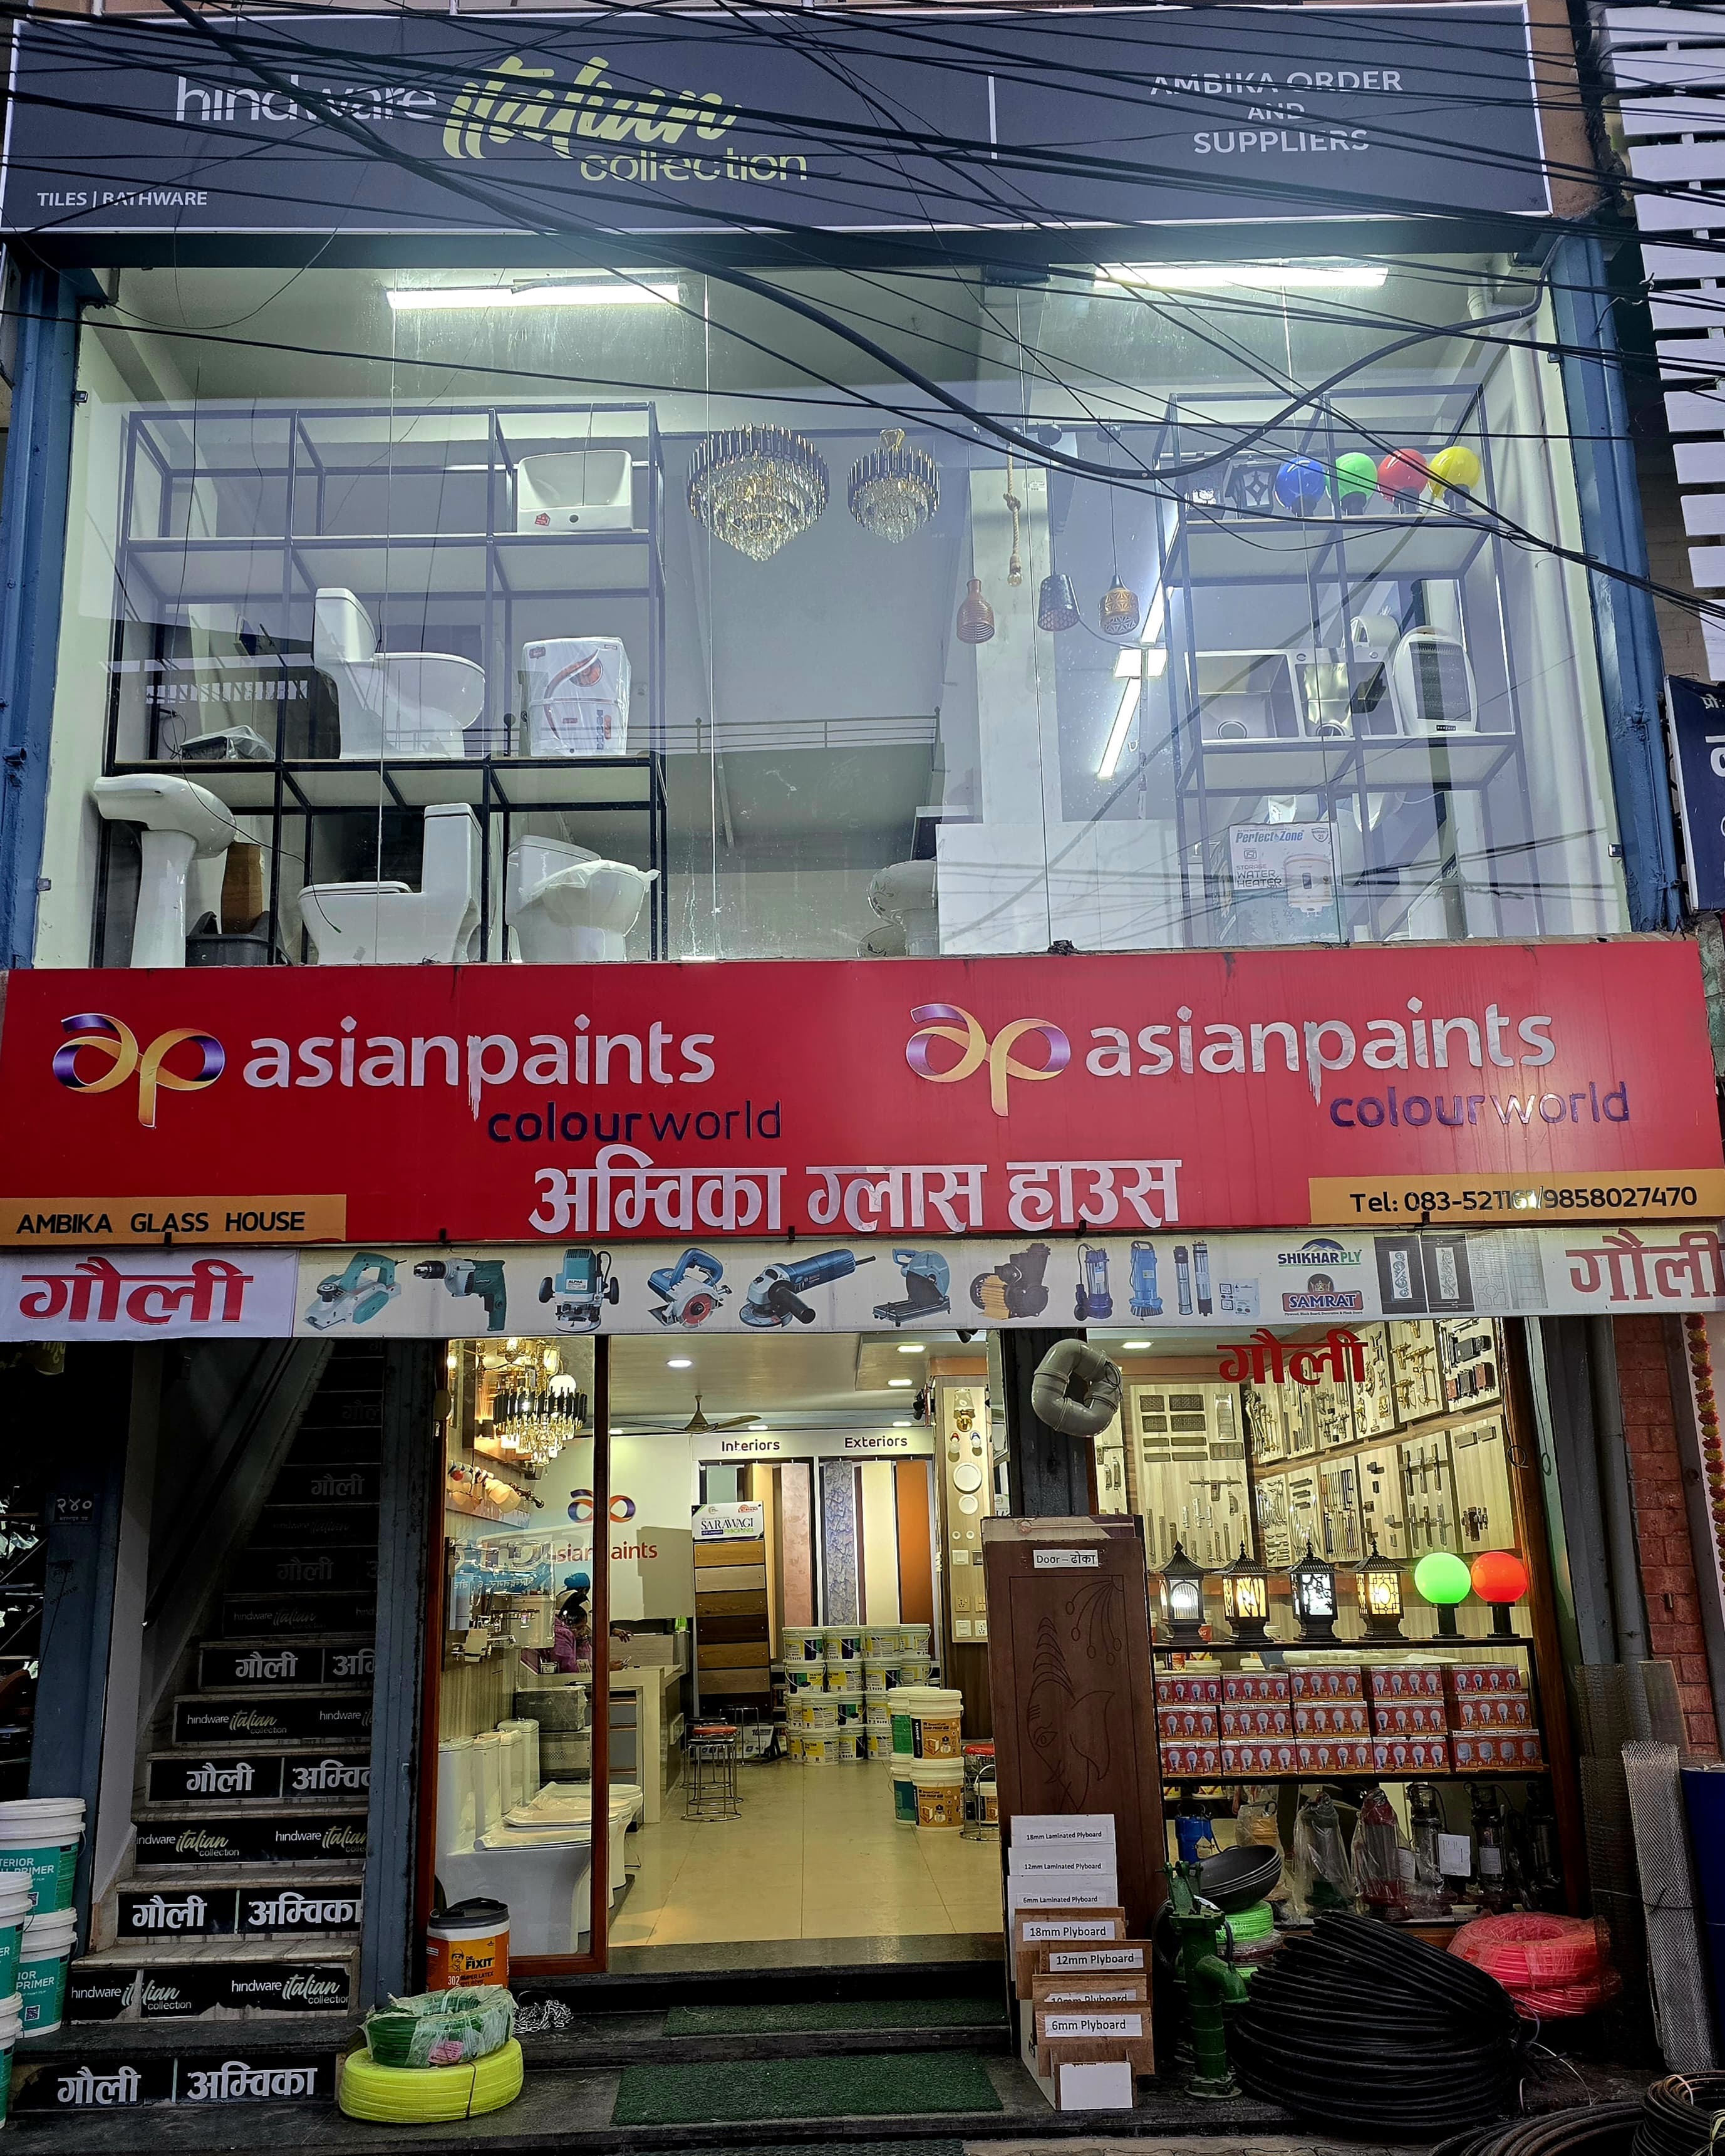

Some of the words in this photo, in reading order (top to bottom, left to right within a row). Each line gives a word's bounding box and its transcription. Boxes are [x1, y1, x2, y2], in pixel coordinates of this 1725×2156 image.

[1151, 73, 1278, 95] AMBIKA
[1287, 70, 1403, 93] ORDER
[1247, 102, 1305, 120] AND
[1194, 130, 1370, 153] SUPPLIERS
[580, 147, 807, 182] collection
[38, 192, 87, 207] TILES
[103, 190, 208, 207] BATHWARE
[1236, 831, 1277, 844] Perfect
[1278, 831, 1303, 842] Zone
[1236, 869, 1276, 879] WATER
[1237, 878, 1282, 888] HEATER
[806, 1164, 988, 1233] ग्लास
[1006, 1159, 1183, 1232] हाउस
[1350, 1192, 1398, 1213] Tel:
[16, 1213, 113, 1235] AMBIKA
[130, 1212, 209, 1234] GLASS
[225, 1211, 305, 1232] HOUSE
[1565, 1228, 1725, 1301] गौली
[19, 1256, 254, 1326] गौली
[1289, 1294, 1356, 1308] SAMRAT
[1216, 1328, 1369, 1386] गौली
[721, 1439, 780, 1452] Interiors
[844, 1436, 908, 1449] Exteriors
[311, 1473, 365, 1496] गौली
[701, 1518, 754, 1530] SARAWAGI
[1037, 1555, 1060, 1563] Door
[1069, 1551, 1096, 1564] ढोका
[276, 1556, 334, 1580] गौली
[235, 1651, 299, 1678] गौली
[187, 1714, 229, 1724] hindware
[229, 1709, 277, 1731] italian
[319, 1710, 361, 1721] hindware
[251, 1726, 287, 1734] collection
[186, 1762, 256, 1793] गौली
[136, 1834, 176, 1845] indware
[175, 1829, 229, 1852] italian
[276, 1830, 321, 1842] hindware
[1045, 1832, 1075, 1840] Laminated
[1077, 1831, 1102, 1839] Plyboard
[199, 1848, 240, 1857] collection
[1075, 1863, 1102, 1871] Plyboard
[1072, 1895, 1098, 1904] Plyboard
[132, 1895, 207, 1928] गौली
[1030, 1927, 1060, 1937] 18mm
[1063, 1926, 1106, 1938] Plyboard
[465, 1957, 493, 1970] FIXIT
[1056, 1956, 1087, 1966] 12mm
[1090, 1953, 1134, 1966] Plyboard
[16, 1976, 54, 1991] PRIMER
[231, 1979, 282, 1993] hindware
[282, 1974, 340, 1999] italian
[447, 1975, 460, 1986] 302
[71, 1987, 122, 1999] hindware
[122, 1979, 180, 2006] itlian
[147, 2001, 192, 2010] collection
[1052, 2020, 1078, 2030] 6mm
[1080, 2019, 1126, 2032] Plyboard
[58, 2066, 141, 2105] गौली
